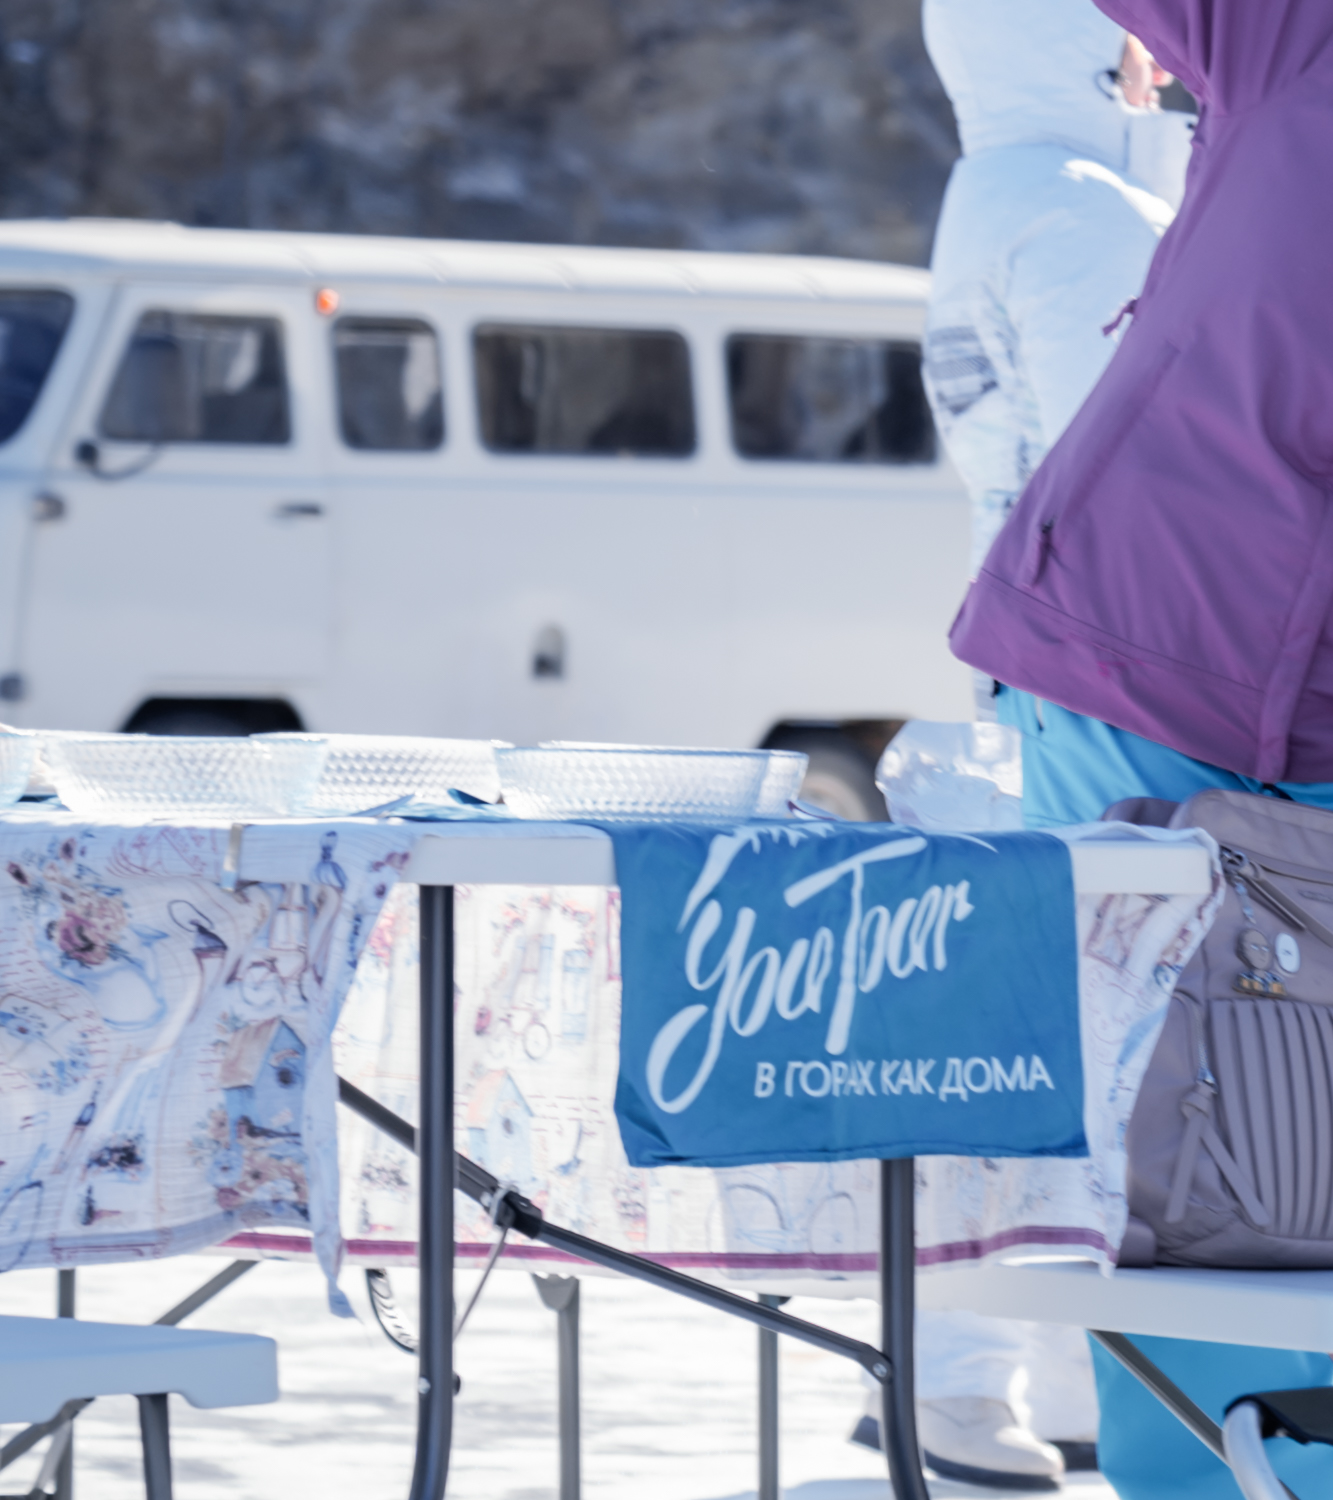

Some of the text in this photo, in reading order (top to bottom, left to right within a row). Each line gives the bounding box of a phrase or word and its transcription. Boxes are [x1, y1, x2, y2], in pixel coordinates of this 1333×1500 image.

[754, 1054, 1056, 1102] В ГОРАХ КАК ДОМА
